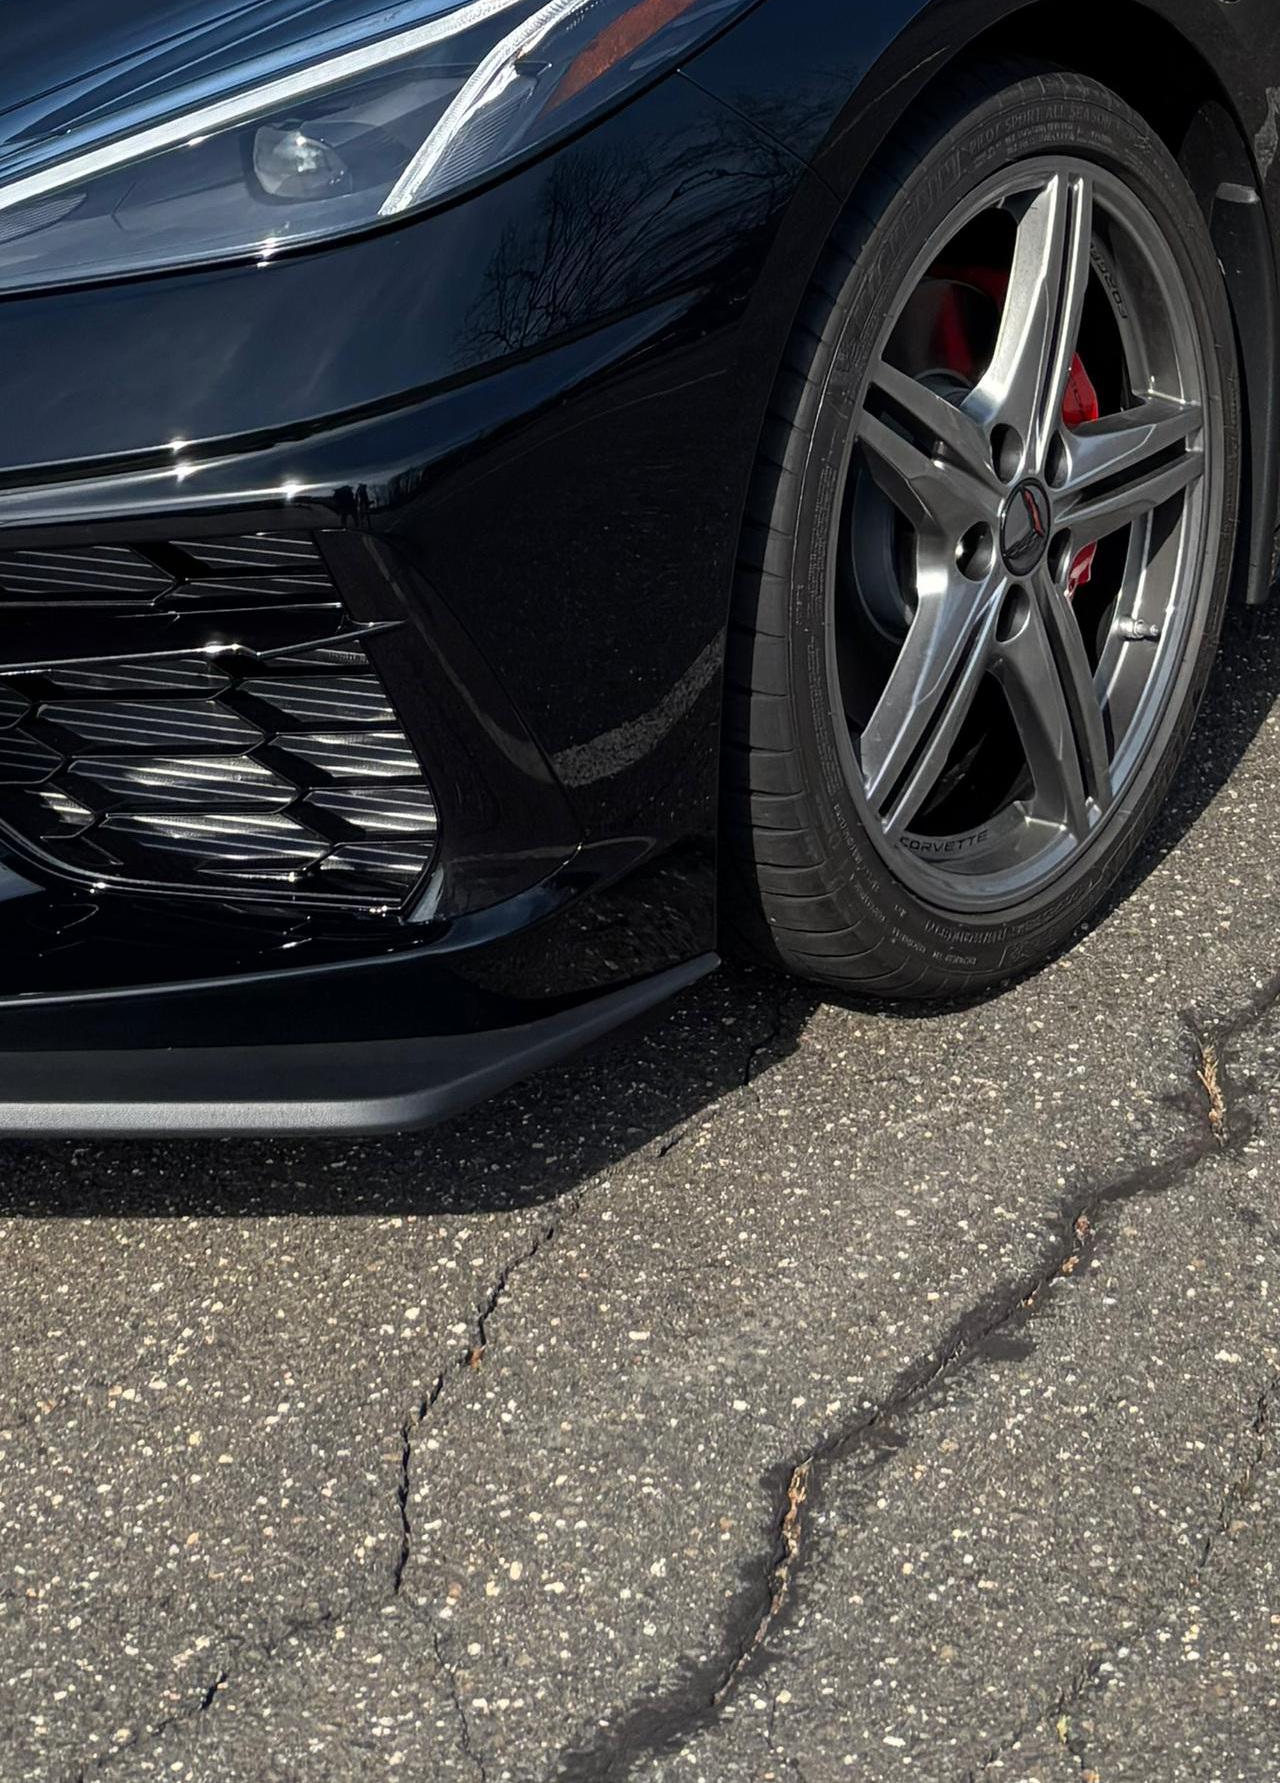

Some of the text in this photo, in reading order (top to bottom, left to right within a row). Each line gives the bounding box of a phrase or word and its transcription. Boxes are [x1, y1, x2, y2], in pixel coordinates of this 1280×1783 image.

[1004, 106, 1040, 131] SPORT
[1045, 103, 1066, 121] ALL
[899, 829, 989, 852] CORVETTE
